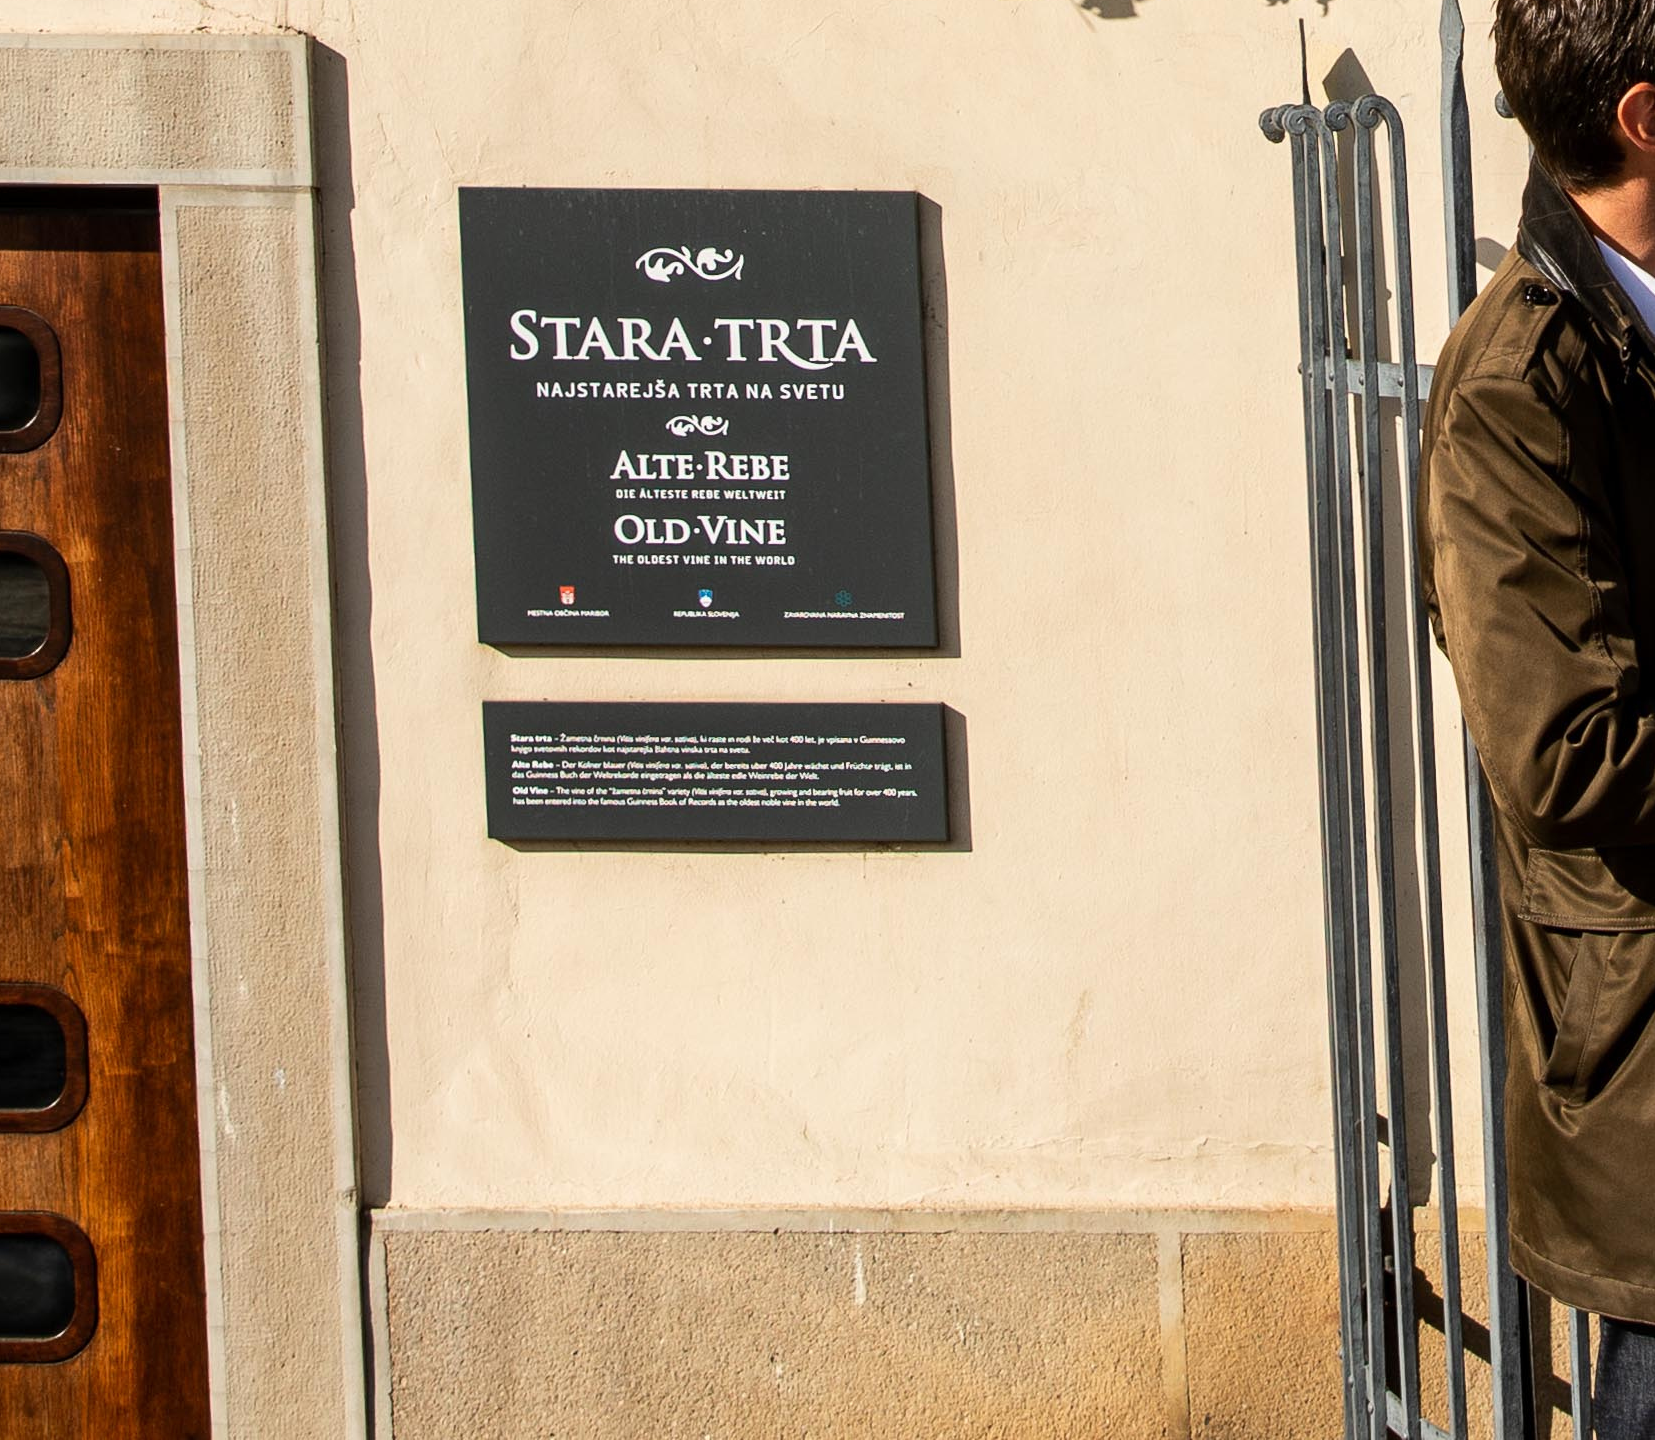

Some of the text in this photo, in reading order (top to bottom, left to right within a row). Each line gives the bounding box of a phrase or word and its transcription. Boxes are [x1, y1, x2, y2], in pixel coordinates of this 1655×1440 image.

[537, 378, 843, 399] NAJSTAREJŠA TRTA NA SVETU
[616, 489, 635, 498] DIE
[691, 489, 719, 499] REBE
[723, 489, 785, 499] WELTWEIT
[613, 554, 794, 565] THE OLDEST VINE IN THE WORLD
